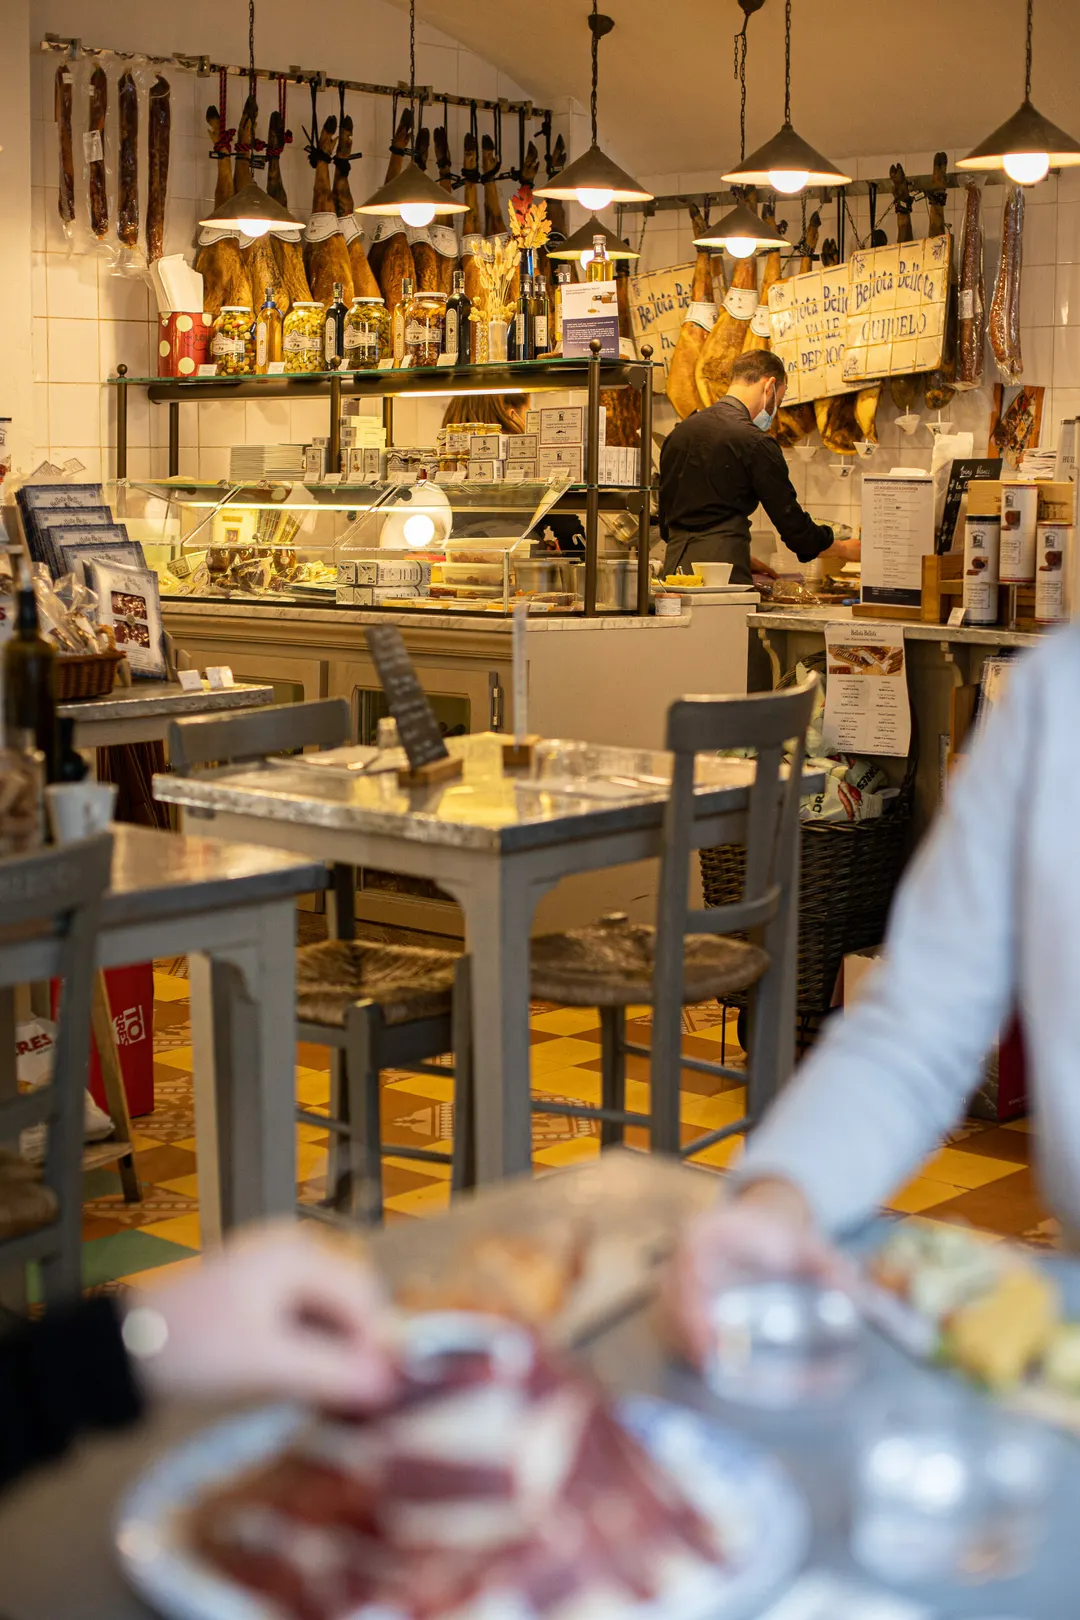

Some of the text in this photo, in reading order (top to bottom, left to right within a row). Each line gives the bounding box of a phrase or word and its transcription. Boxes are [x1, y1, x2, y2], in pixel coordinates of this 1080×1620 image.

[856, 260, 935, 310] Bellota Bellota
[637, 292, 674, 331] Bellota
[857, 765, 881, 790] ORRES
